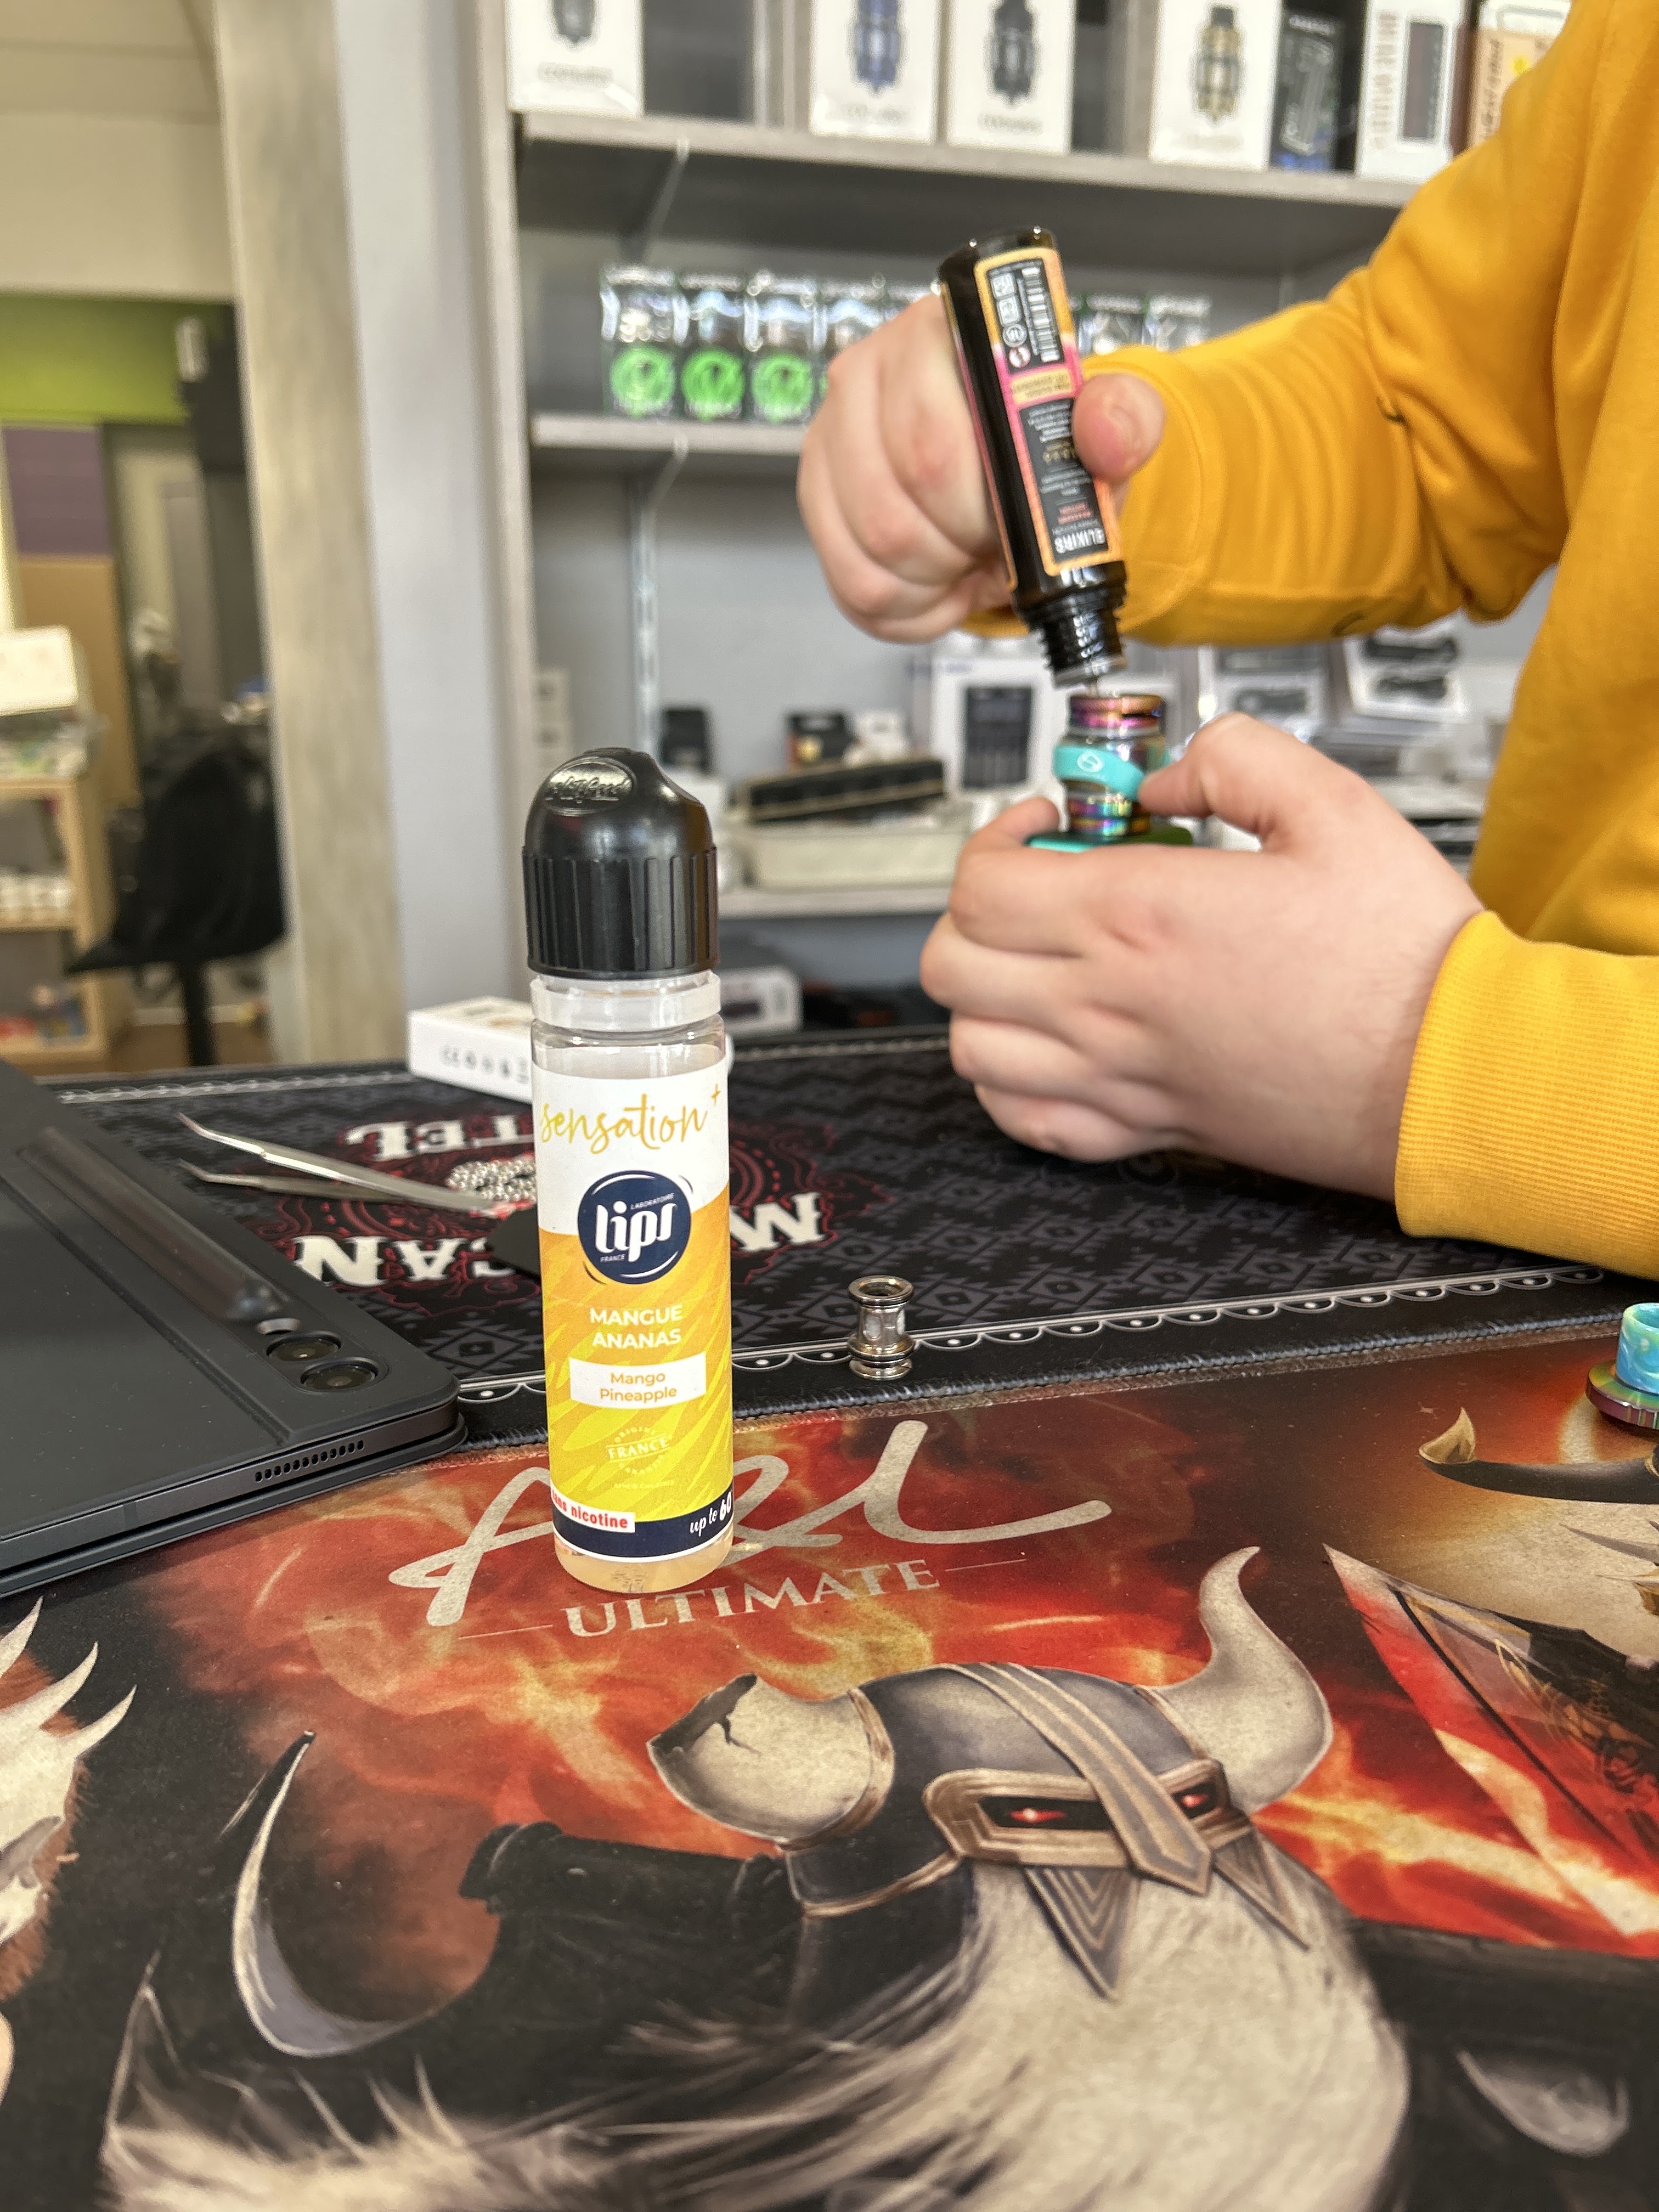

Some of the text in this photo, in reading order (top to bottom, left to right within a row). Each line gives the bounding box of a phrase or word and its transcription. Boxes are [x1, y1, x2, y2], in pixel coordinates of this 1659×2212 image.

[600, 1254, 627, 1263] FRANCE
[589, 1304, 684, 1326] MANGUE
[592, 1328, 681, 1349] ANANAS
[610, 1372, 666, 1387] Mango
[599, 1386, 678, 1404] Pineapple
[607, 1436, 670, 1460] FRANCE
[571, 1505, 628, 1528] nicotine
[690, 1491, 732, 1537] up to 60
[560, 1559, 941, 1638] ULTIMATE
